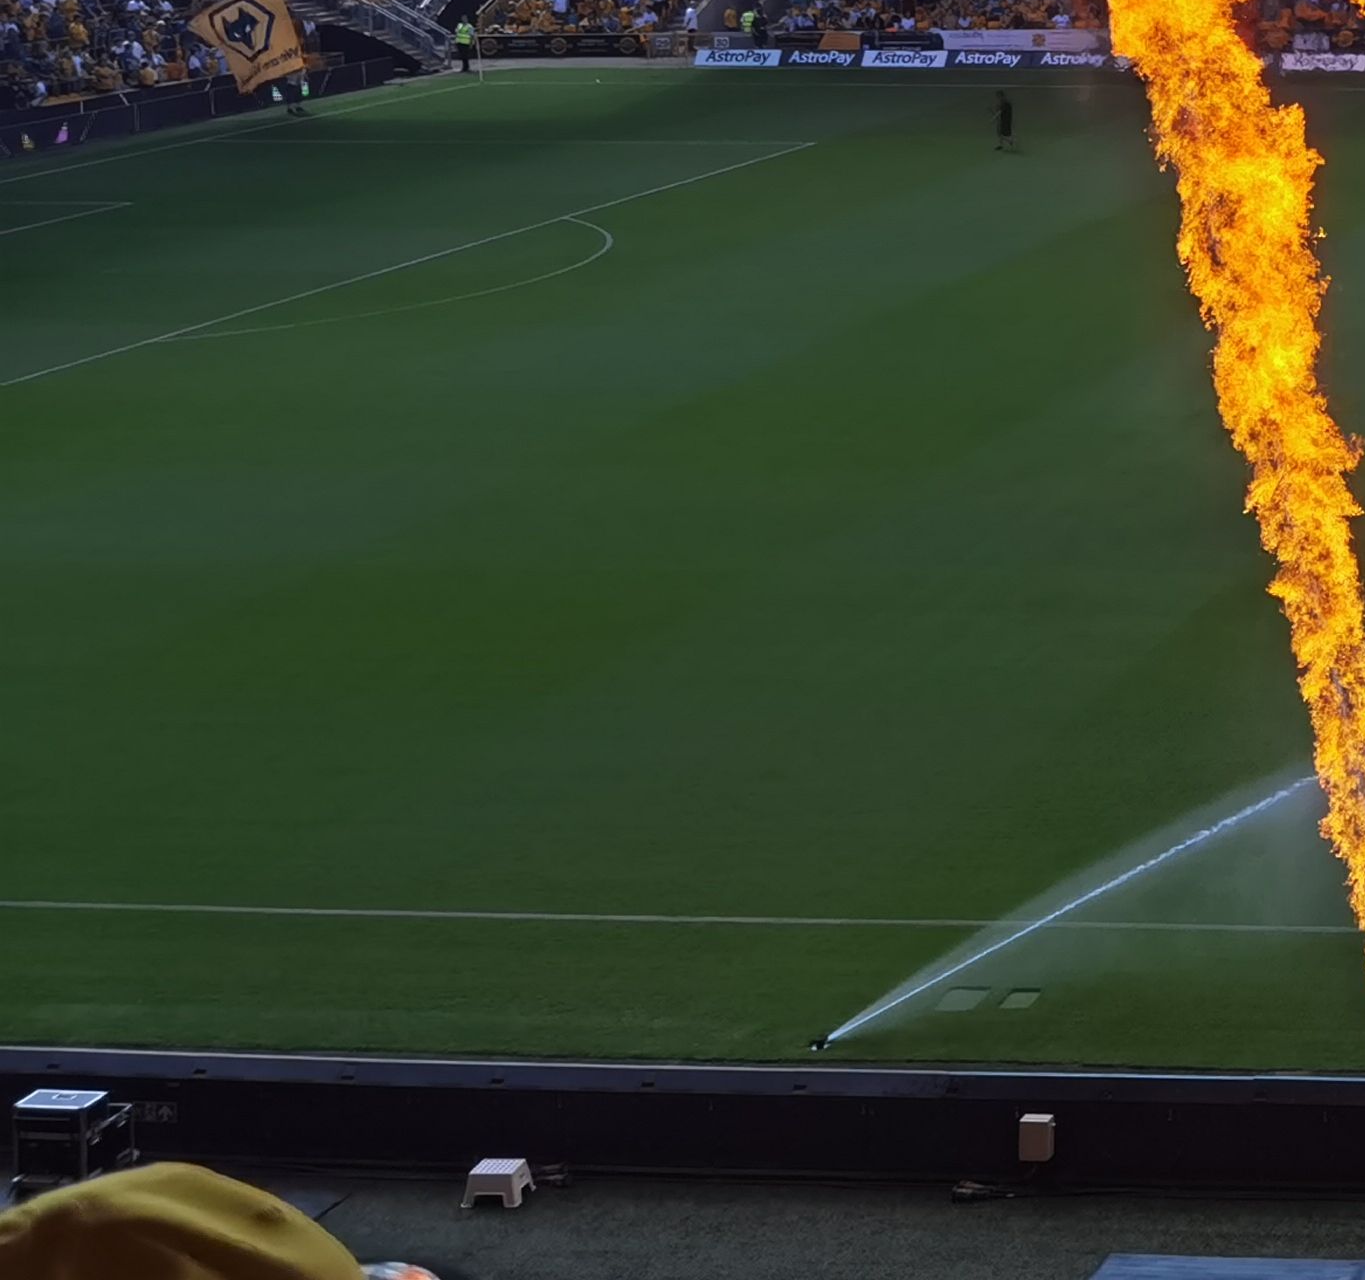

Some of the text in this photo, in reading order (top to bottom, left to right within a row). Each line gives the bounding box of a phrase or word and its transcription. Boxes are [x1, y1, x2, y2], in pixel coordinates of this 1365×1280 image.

[705, 48, 771, 66] AstroPay
[788, 50, 855, 65] AstroPay
[872, 51, 937, 66] AstroPay
[955, 50, 1021, 67] AstroPay
